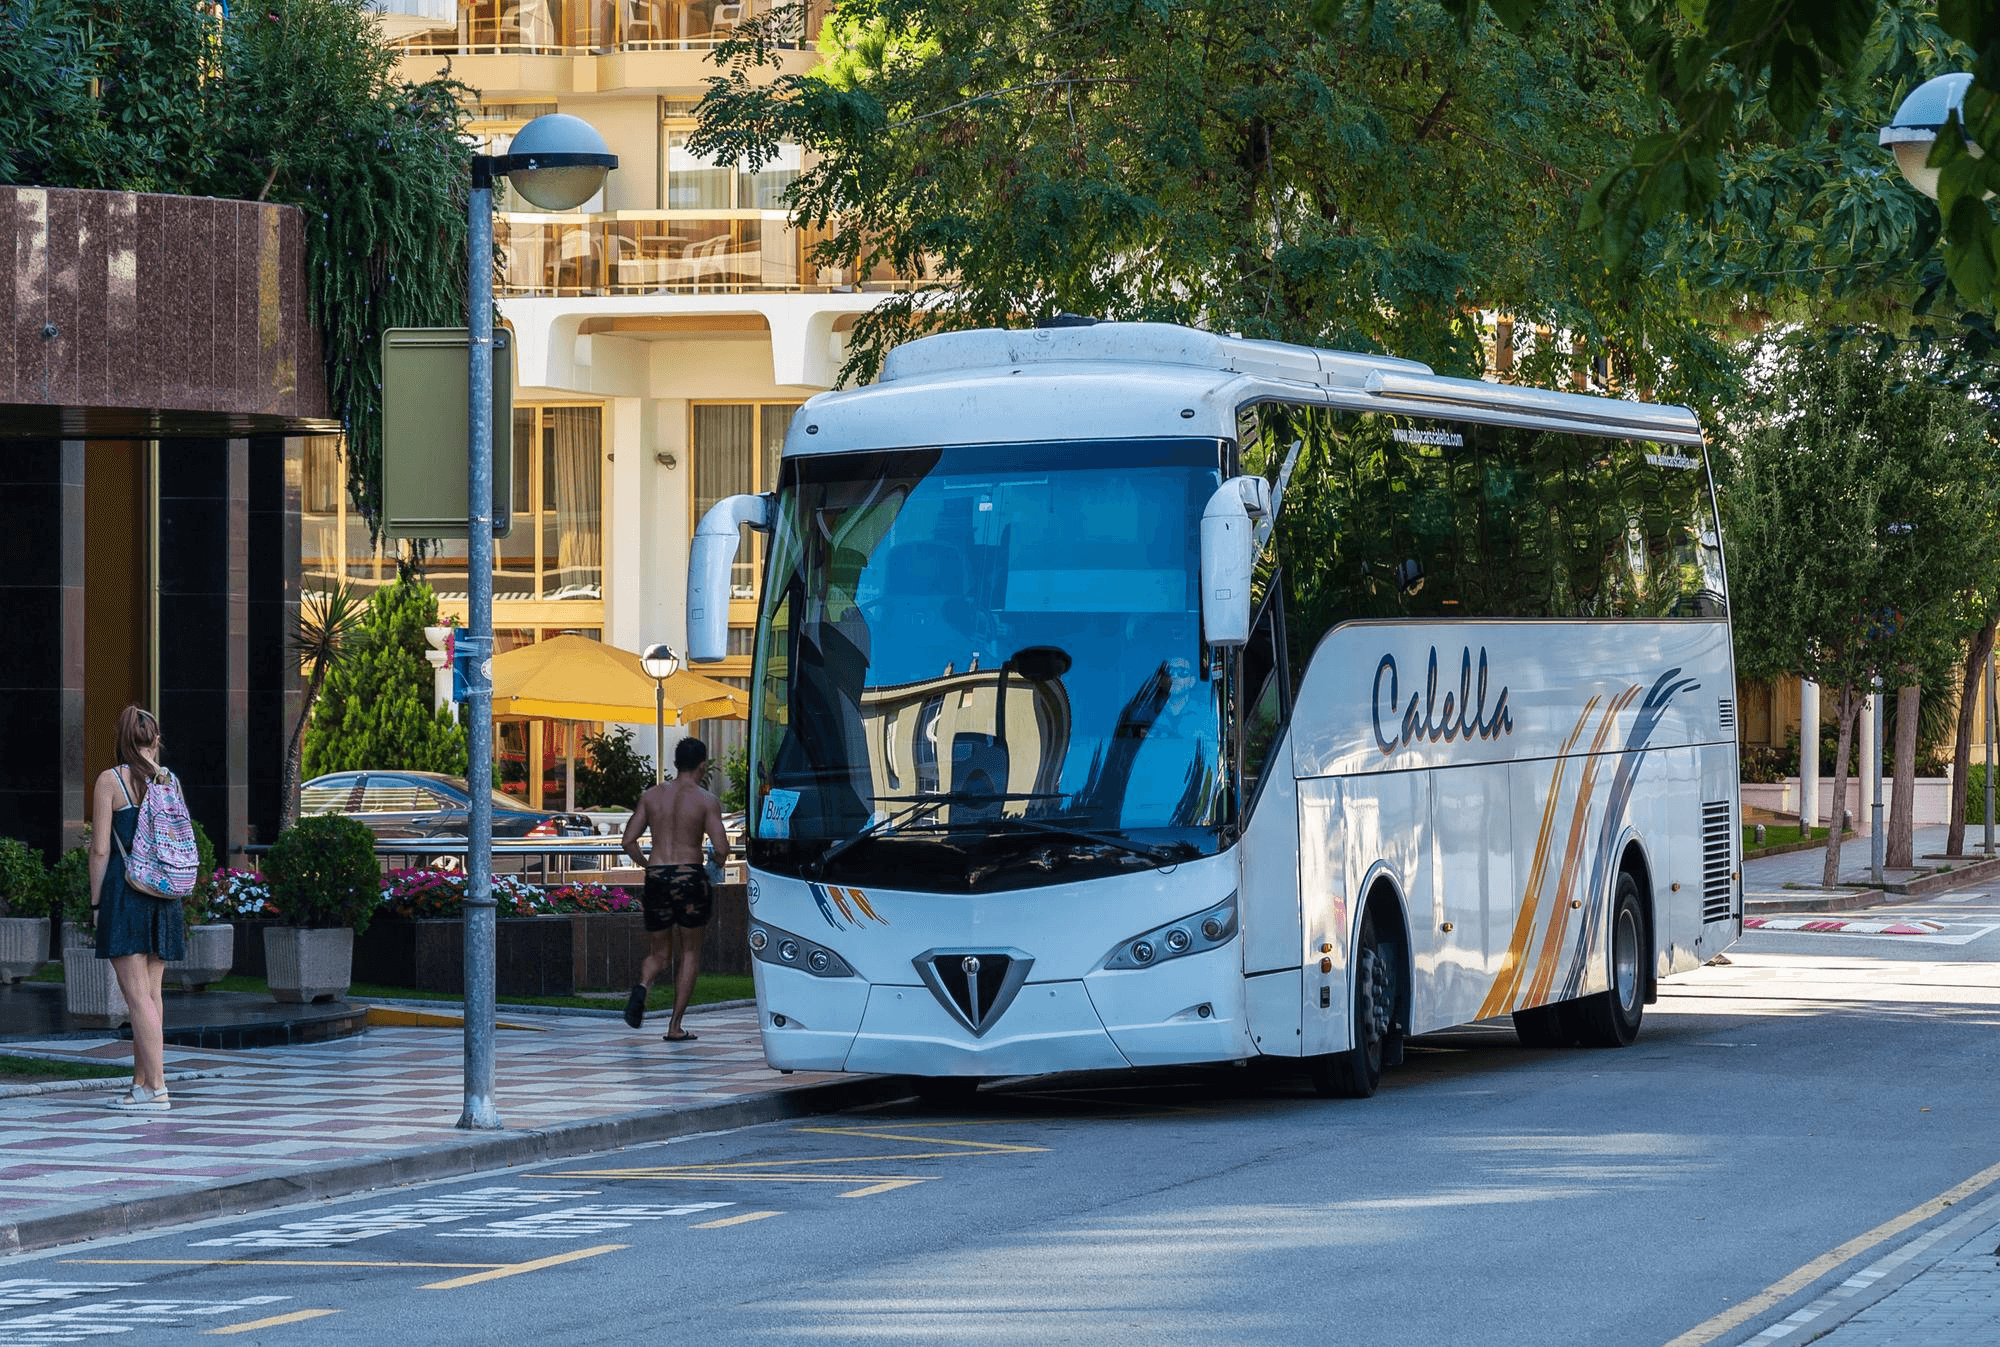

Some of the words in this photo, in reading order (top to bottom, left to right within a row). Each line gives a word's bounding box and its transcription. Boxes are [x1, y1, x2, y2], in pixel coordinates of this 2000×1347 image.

[1372, 645, 1514, 756] Calella
[766, 800, 783, 820] Bus
[187, 1187, 603, 1247] RESERVAT
[435, 1202, 737, 1239] HOTEL
